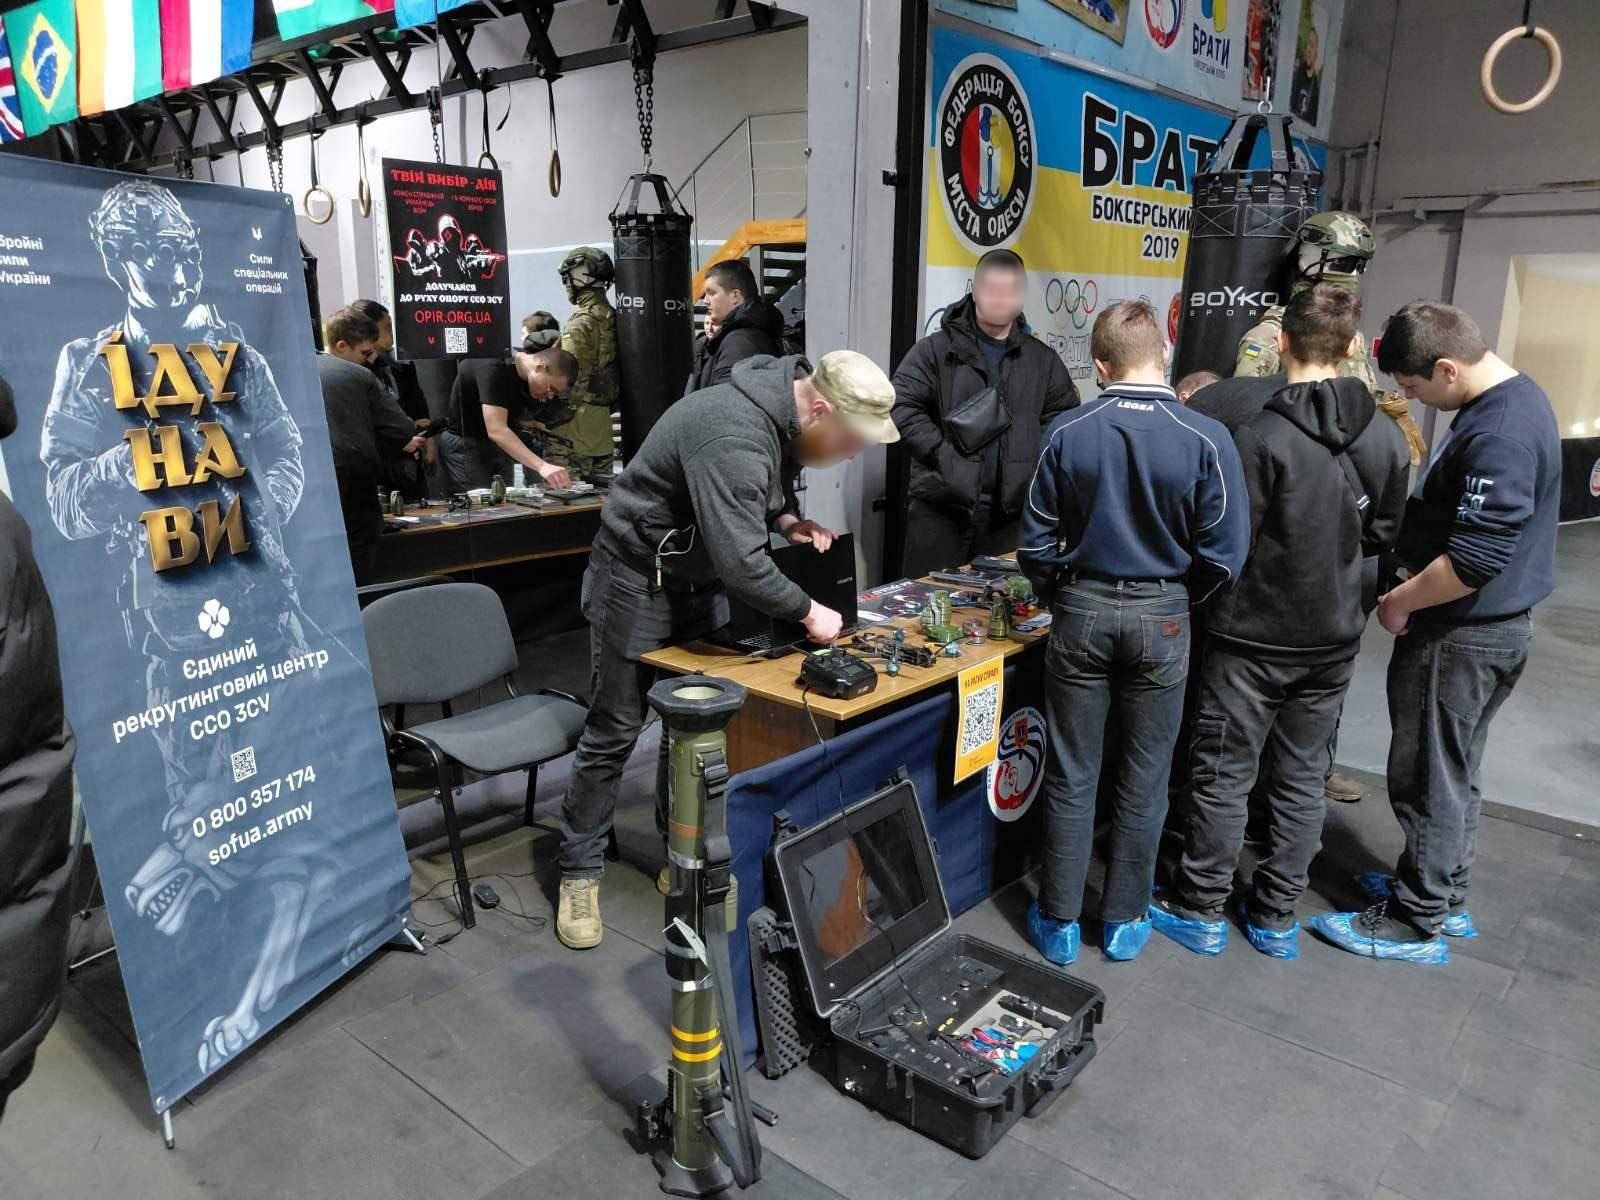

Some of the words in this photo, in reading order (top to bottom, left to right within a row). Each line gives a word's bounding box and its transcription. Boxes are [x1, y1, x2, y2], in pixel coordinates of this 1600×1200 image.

[1193, 22, 1230, 69] БРАТИ
[944, 72, 1004, 147] ФЕДЕРАЦІЯ
[1006, 95, 1030, 168] БОКСУ
[1082, 93, 1219, 192] БРАТ
[391, 169, 424, 183] ТВІЙ
[427, 172, 469, 187] ВИБІР
[475, 177, 497, 191] ДІЯ
[947, 172, 981, 238] МІСТА
[987, 187, 1026, 238] ОДЕСИ
[1093, 195, 1193, 231] БОКСЕРСЬКИЙ
[0, 234, 44, 250] бройні
[249, 253, 273, 265] Сили
[1143, 234, 1179, 259] 2019
[234, 267, 289, 280] спеціальних
[245, 282, 282, 294] операцій
[425, 282, 477, 292] ДОЛУЧАЙСЯ
[400, 293, 413, 303] ДО
[414, 294, 438, 303] РУХУ
[438, 294, 469, 304] ОПОРУ
[469, 295, 486, 304] ССО
[486, 295, 504, 304] ЗСУ
[1189, 309, 1257, 317] SPOR
[1190, 286, 1280, 307] BOYKO
[414, 310, 492, 324] OPIR.ORG.UA
[98, 330, 240, 419] ІДУ
[123, 421, 247, 492] НА
[137, 492, 252, 574] ВИ
[182, 638, 258, 680] Єдиний
[112, 664, 268, 743] рекрутинговий
[272, 649, 330, 680] центр
[190, 710, 231, 741] ССО
[233, 693, 272, 723] ЗСУ
[192, 817, 206, 838] 0
[210, 796, 248, 830] 800
[250, 778, 282, 811] 357
[285, 765, 317, 793] 174
[208, 801, 314, 866] sofua.army
